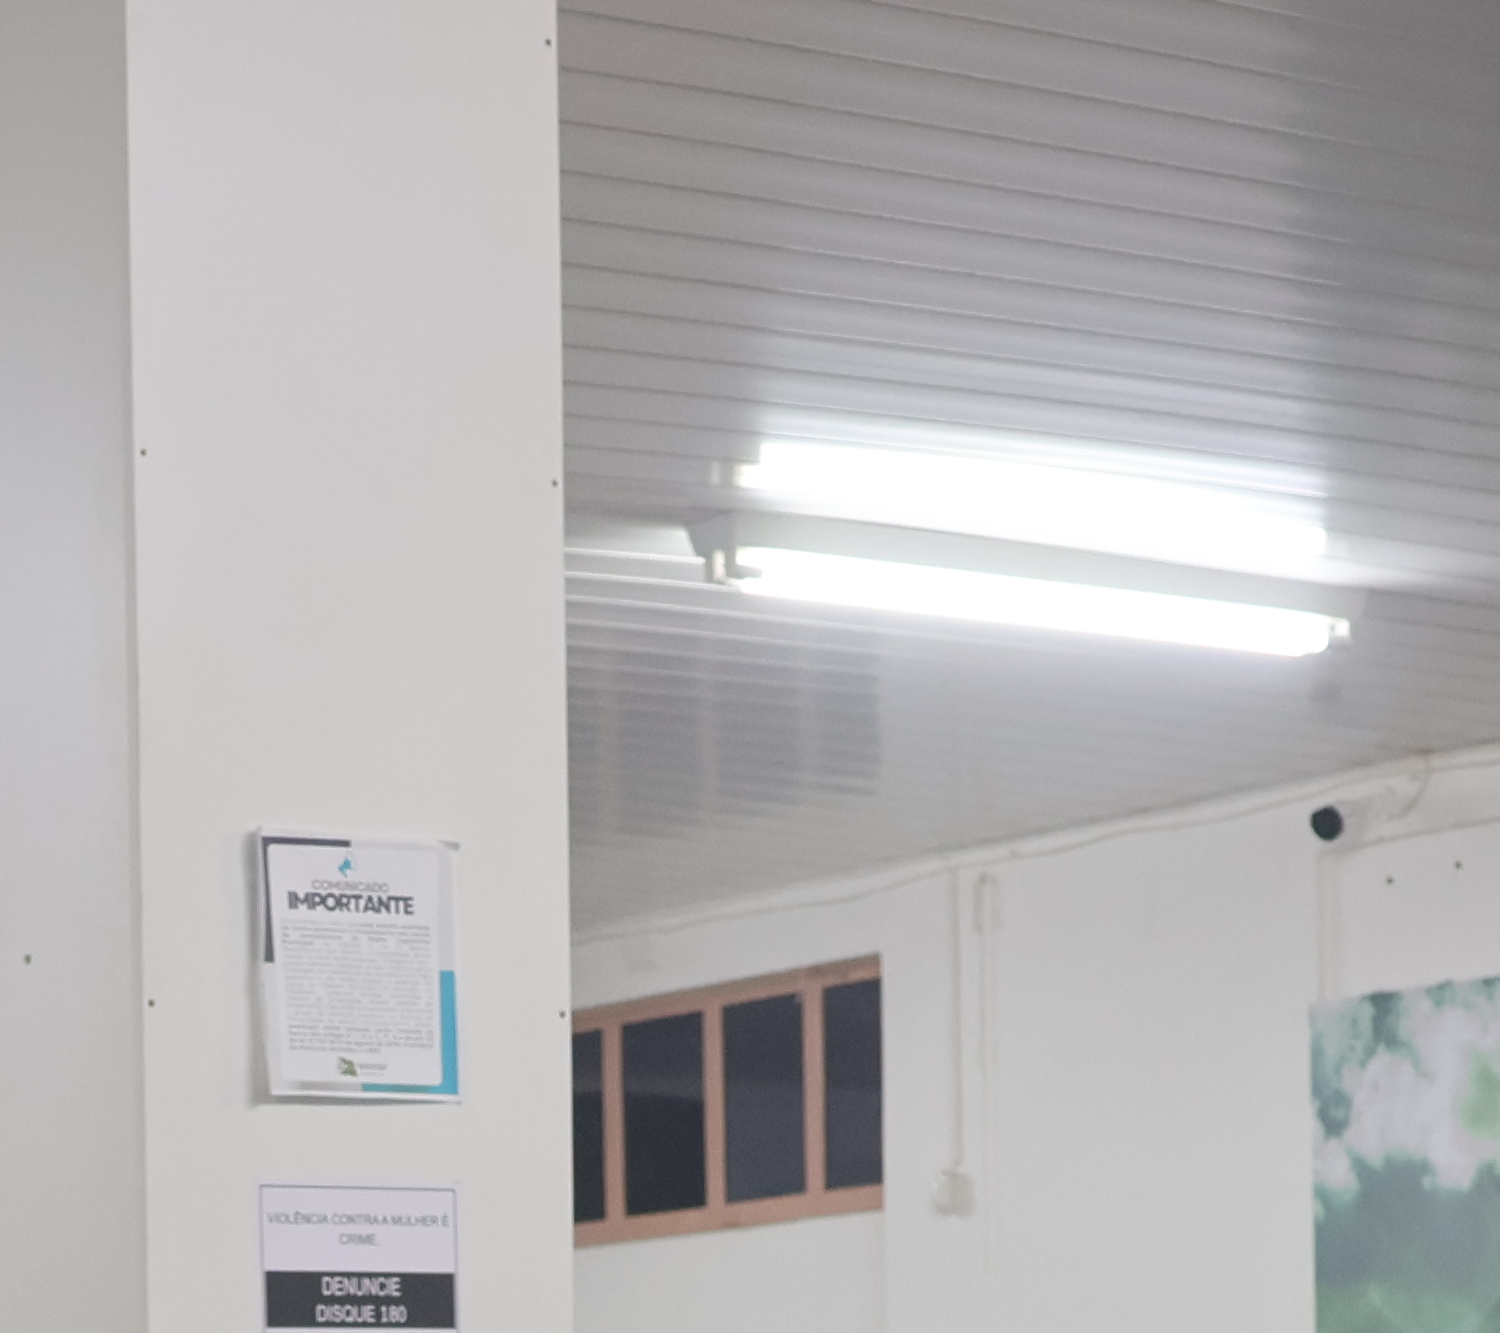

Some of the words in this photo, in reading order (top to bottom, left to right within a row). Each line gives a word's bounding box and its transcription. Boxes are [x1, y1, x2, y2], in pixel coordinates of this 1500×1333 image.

[311, 879, 390, 893] COMUNICADO
[287, 891, 416, 915] IMPORTANTE
[267, 1211, 329, 1225] VIOLÊNCIA
[331, 1212, 378, 1226] CONTRA
[390, 1213, 440, 1227] MULHER
[321, 1276, 402, 1297] DENUNCIE
[315, 1303, 376, 1323] DISQUE
[380, 1305, 408, 1324] 180
